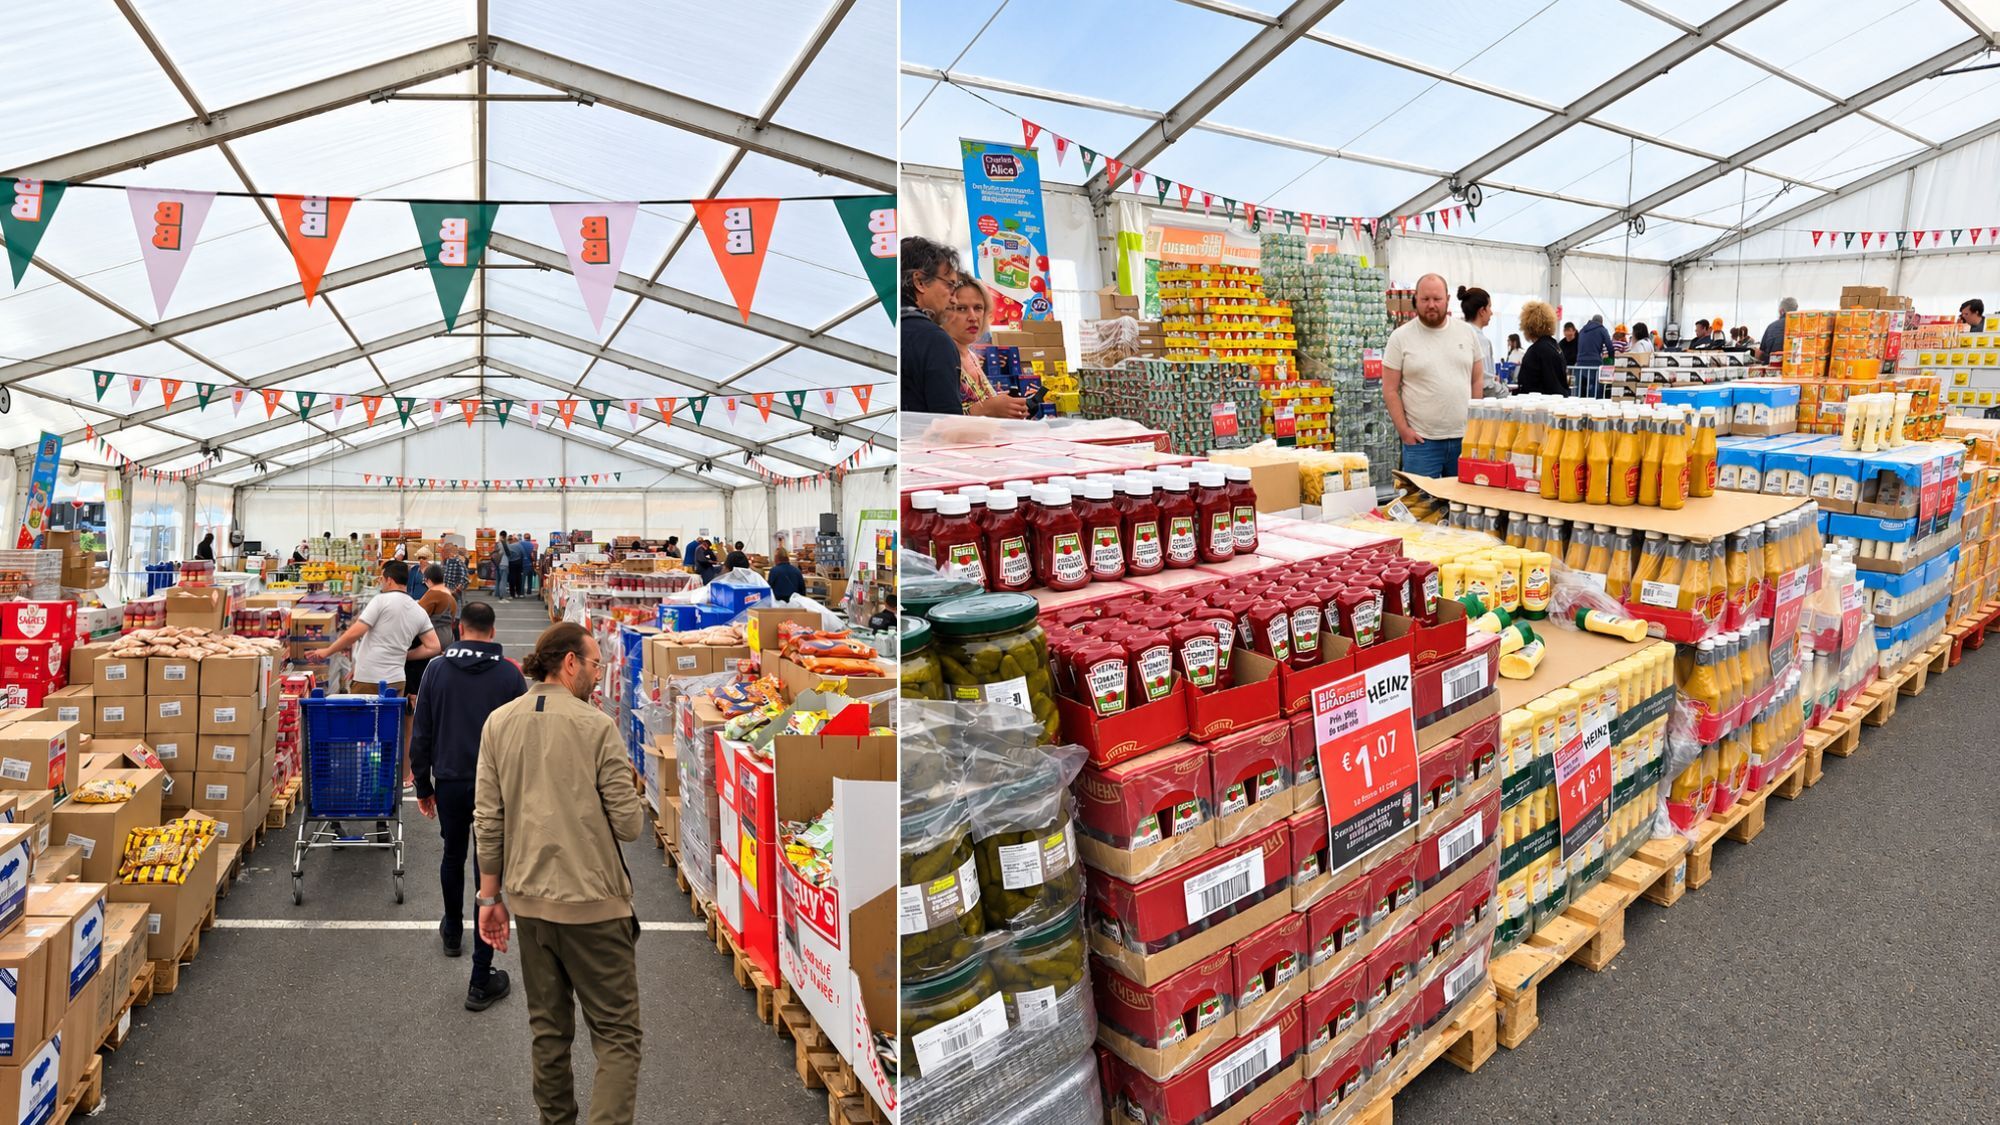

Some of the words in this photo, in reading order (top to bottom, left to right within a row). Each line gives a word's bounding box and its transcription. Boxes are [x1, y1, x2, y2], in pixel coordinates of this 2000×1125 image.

[990, 163, 1014, 175] Alice
[1318, 688, 1337, 703] BIG
[1319, 687, 1366, 713] BRADERIE
[1367, 675, 1409, 704] HEINZ
[1583, 724, 1608, 750] HEINZ
